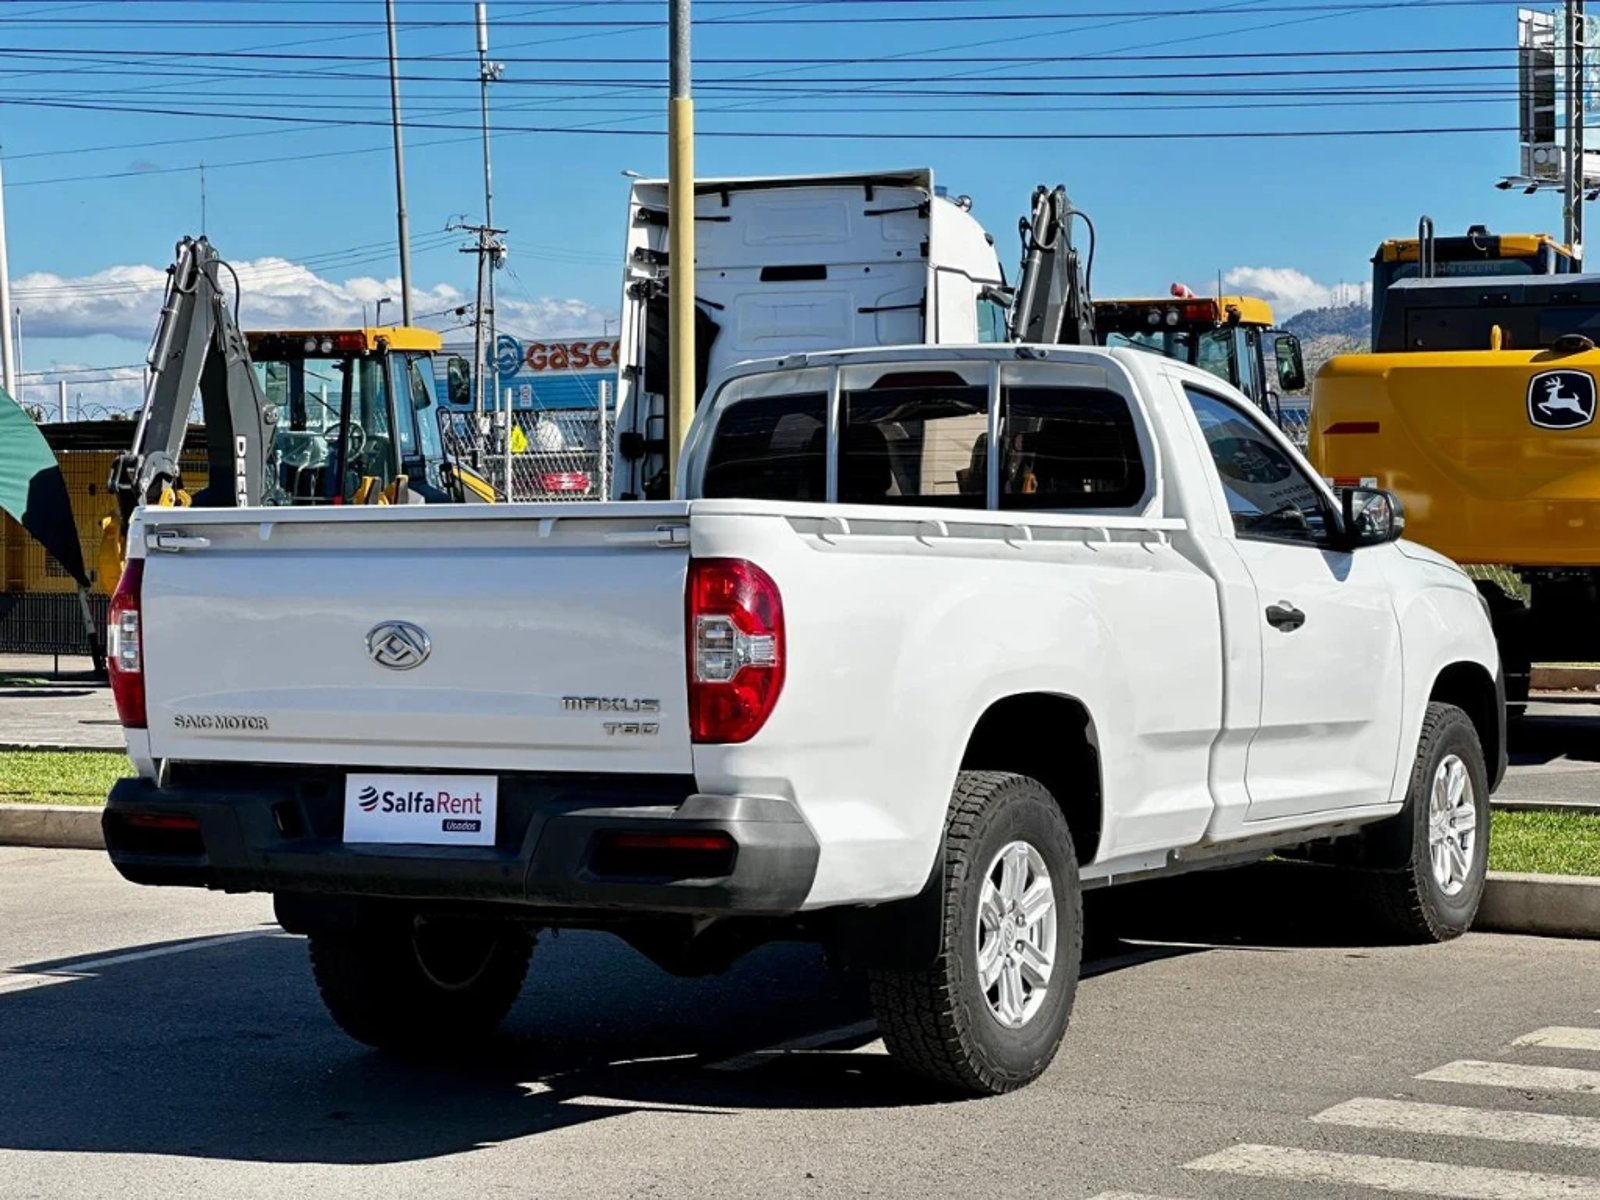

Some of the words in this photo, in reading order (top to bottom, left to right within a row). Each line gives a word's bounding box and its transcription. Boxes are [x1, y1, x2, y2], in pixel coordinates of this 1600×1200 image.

[562, 696, 660, 712] MAXUS
[173, 714, 213, 729] SAIC
[214, 714, 270, 730] MOTOR
[603, 722, 660, 736] T60
[381, 790, 483, 815] SalfaRent
[446, 820, 477, 831] Usados
